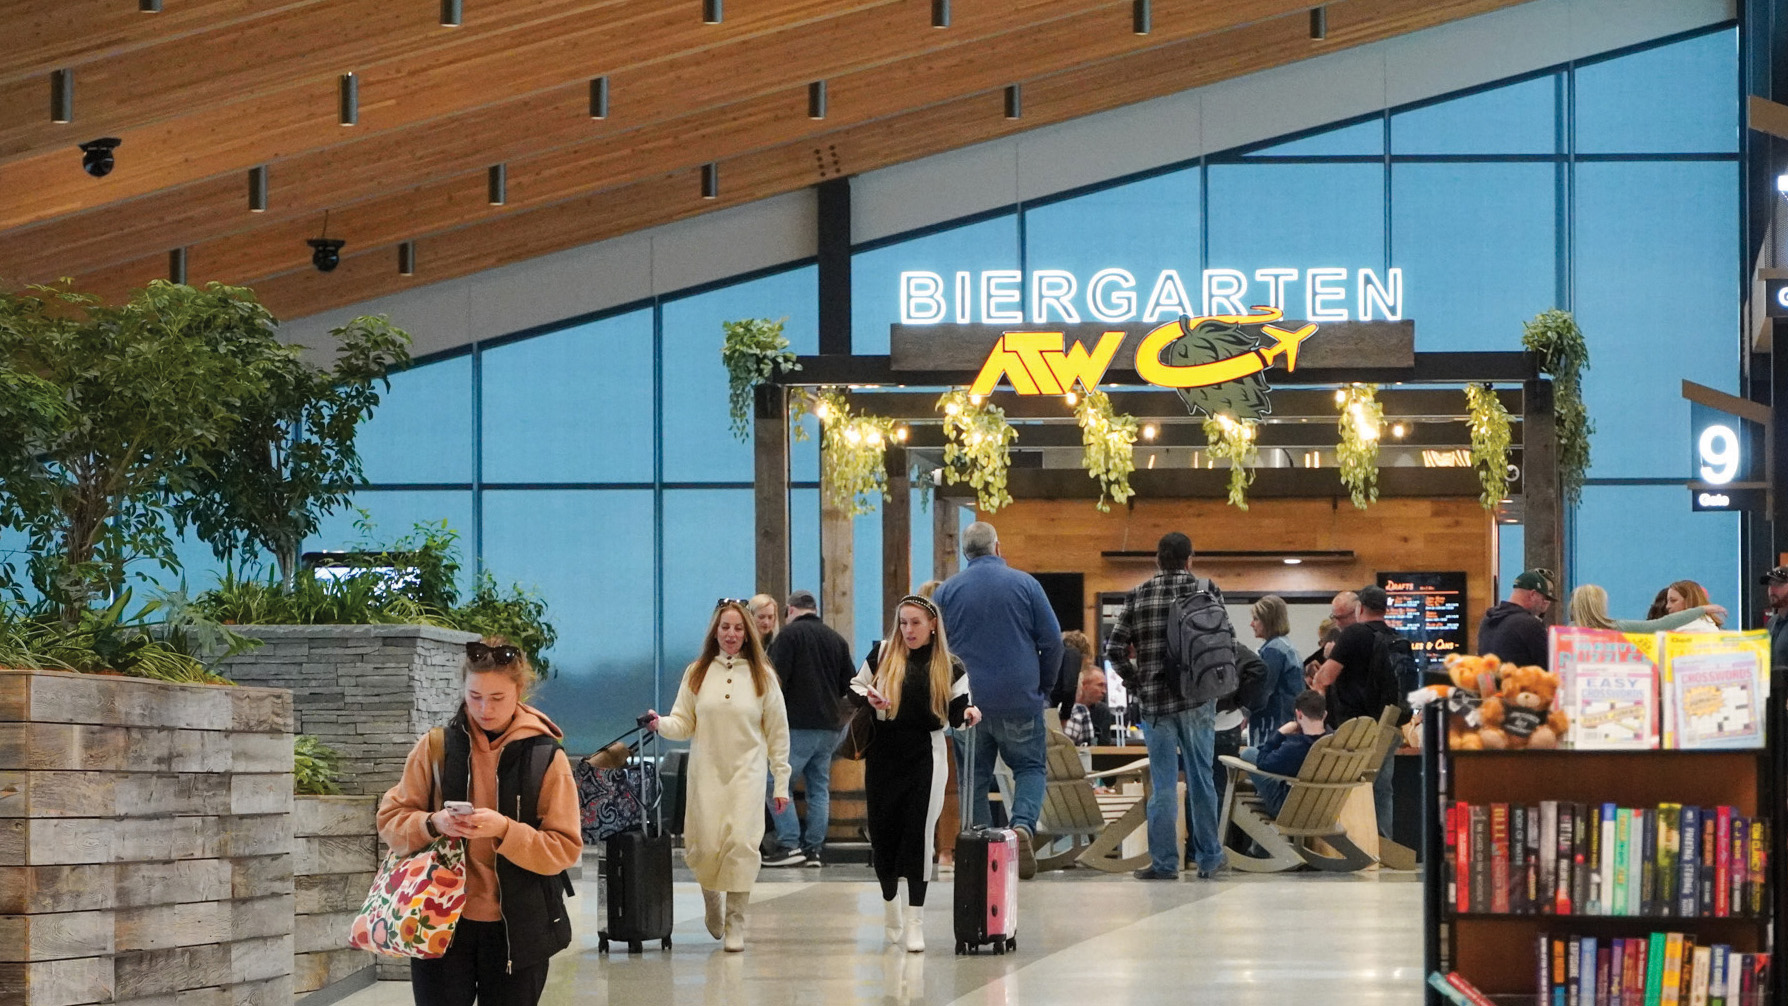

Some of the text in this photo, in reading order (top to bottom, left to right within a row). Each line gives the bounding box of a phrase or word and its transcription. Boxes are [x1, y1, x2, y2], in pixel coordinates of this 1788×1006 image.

[899, 267, 1404, 325] BIERGARTEN
[968, 330, 1127, 396] ATW
[1698, 424, 1740, 485] 9
[1698, 492, 1730, 506] Gate
[1587, 678, 1638, 688] EASY
[1681, 668, 1753, 683] CROSSWORDS
[1752, 822, 1761, 839] TOM
[1750, 841, 1762, 871] CLANCY
